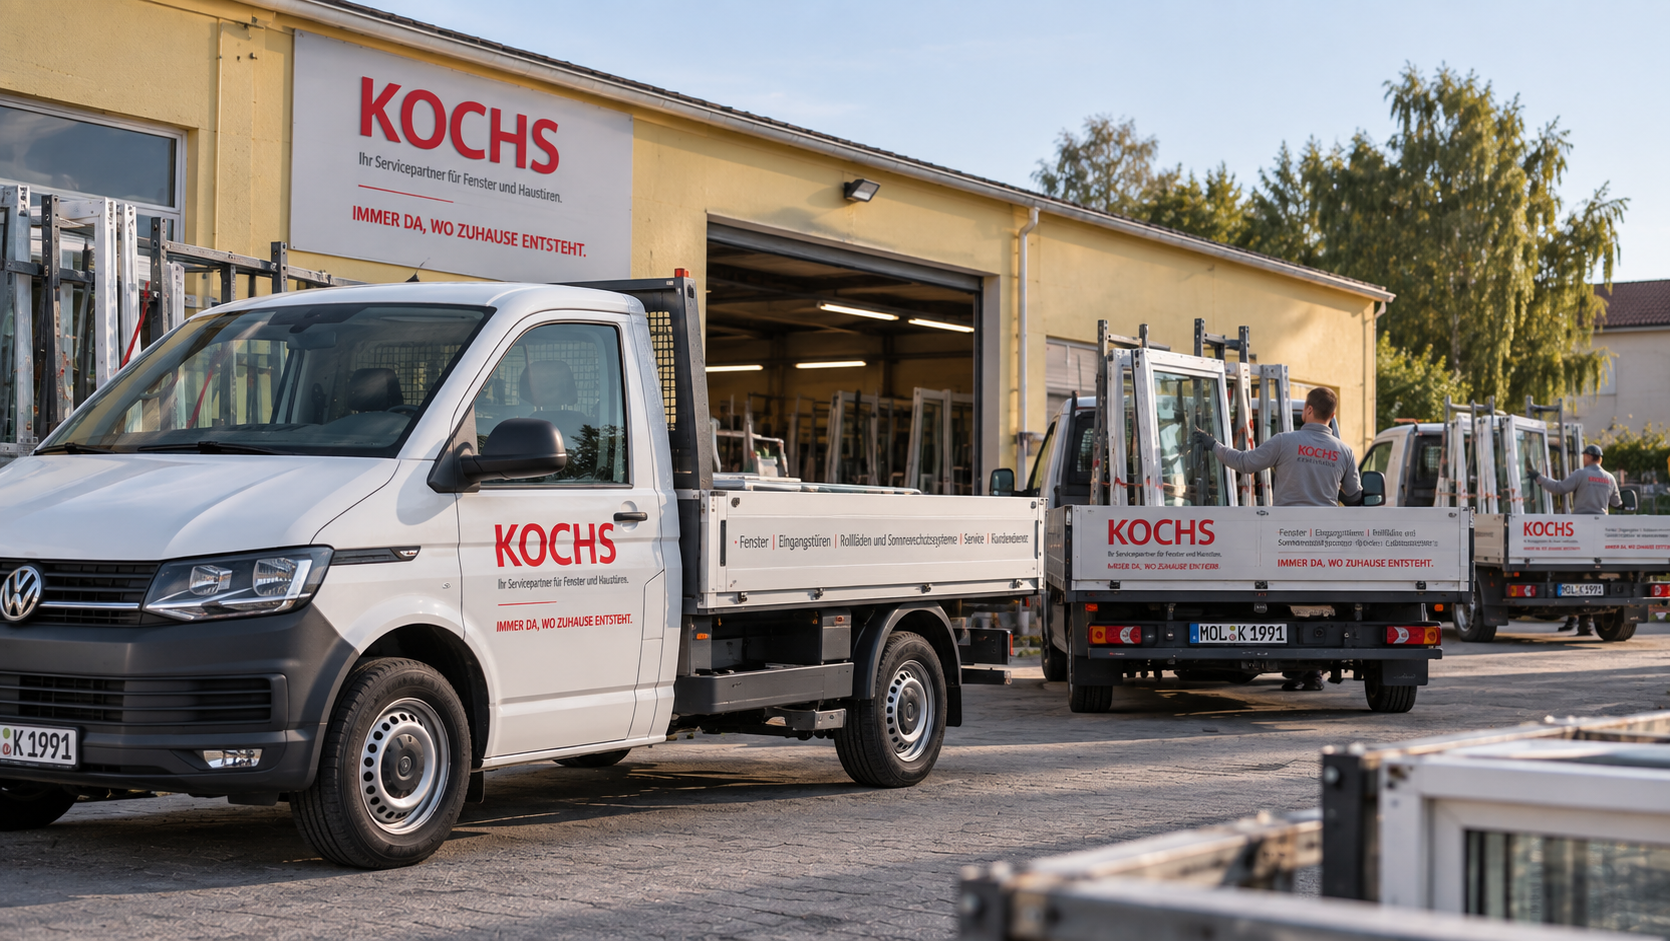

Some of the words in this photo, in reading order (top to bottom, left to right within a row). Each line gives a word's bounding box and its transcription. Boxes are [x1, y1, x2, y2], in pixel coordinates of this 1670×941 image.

[359, 76, 560, 174] KOCHS
[358, 151, 373, 167] Ihr
[375, 155, 446, 181] Servicepartner
[447, 169, 461, 184] für
[463, 173, 497, 191] Fenster
[499, 182, 517, 195] und
[352, 205, 401, 228] IMMER
[403, 213, 427, 235] DA,
[430, 218, 454, 236] WO
[457, 223, 518, 247] ZUHAUSE
[522, 233, 587, 258] ENTSTEHT.
[1297, 444, 1340, 462] KOCHS
[1108, 518, 1216, 545] KOCHS
[1523, 521, 1575, 537] KOCHS
[494, 523, 617, 568] KOCHS
[739, 535, 770, 549] Fenster
[778, 534, 832, 551] Eingangstüren
[873, 534, 887, 546] und
[1277, 559, 1308, 568] IMMER
[1310, 559, 1326, 568] DA,
[1328, 559, 1343, 568] WO
[1345, 559, 1386, 568] ZUHAUSE
[1388, 559, 1434, 568] ENTSTEHT.
[498, 578, 506, 590] Ihr
[563, 576, 586, 587] Fenster
[496, 620, 524, 632] IMMER
[526, 619, 540, 632] DA,
[541, 618, 556, 629] WO
[557, 616, 594, 628] ZUHAUSE
[595, 613, 633, 626] ENTSTEHT.
[1200, 625, 1227, 641] MOL
[1238, 625, 1246, 641] K
[1250, 625, 1285, 641] 1991
[13, 729, 24, 756] K
[27, 730, 72, 760] 1991
